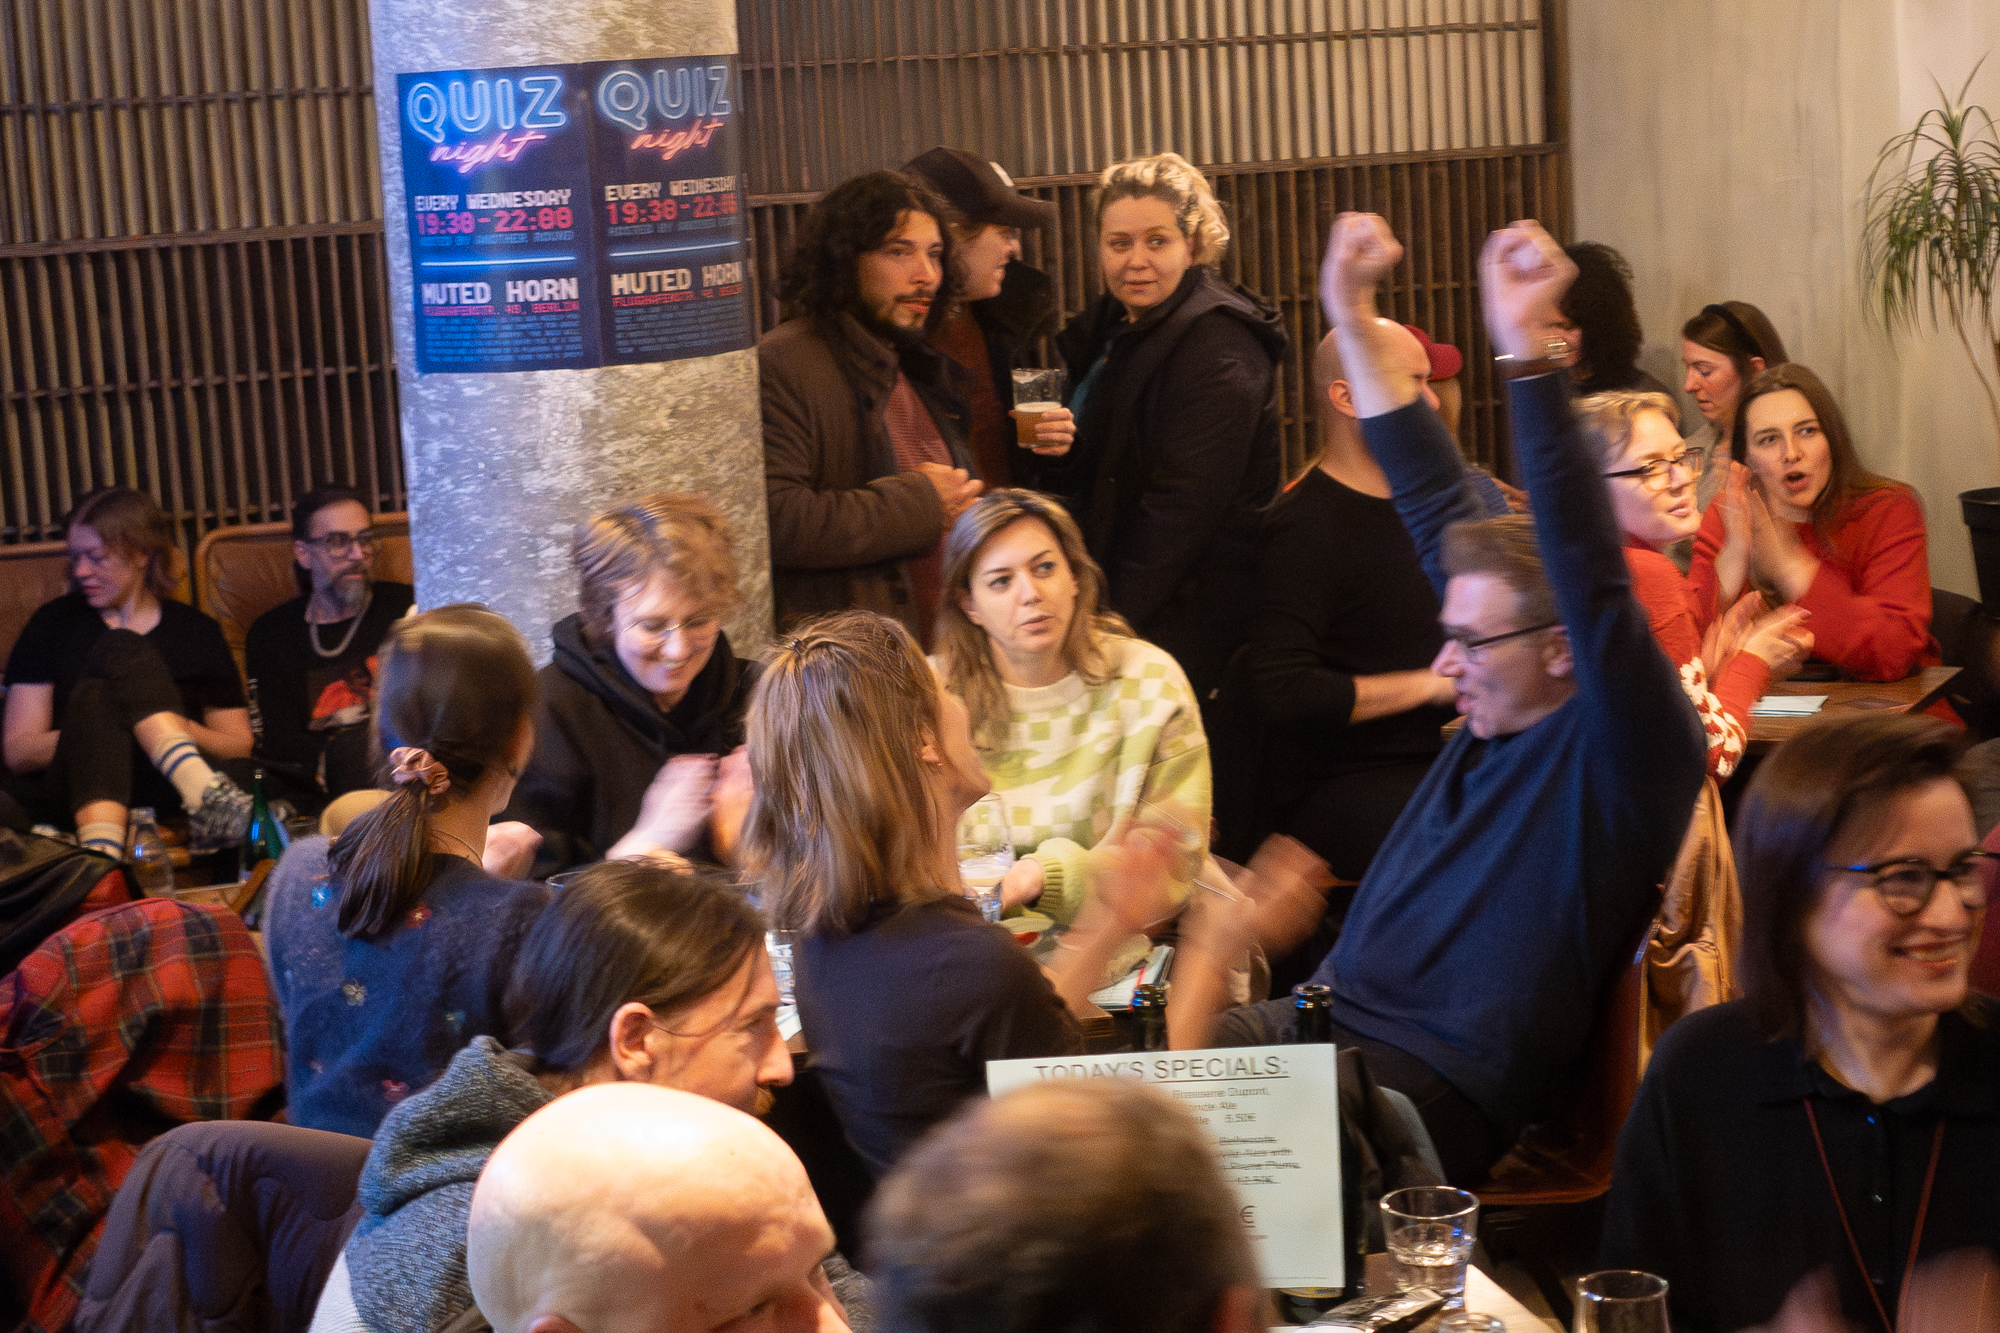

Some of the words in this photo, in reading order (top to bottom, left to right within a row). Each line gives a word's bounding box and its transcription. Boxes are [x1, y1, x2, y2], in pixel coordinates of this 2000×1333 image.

[407, 75, 566, 143] QUIZ
[598, 65, 732, 131] QUIZ
[429, 130, 547, 173] night
[630, 117, 724, 160] night
[414, 195, 459, 211] EVERY
[466, 189, 571, 210] WEDNESDAY
[604, 182, 662, 201] EVERY
[669, 175, 737, 196] WEDNESDAY
[421, 282, 491, 304] MUTED
[505, 277, 579, 303] HORN
[610, 268, 693, 296] MUTED
[701, 261, 743, 288] HORN
[1153, 1056, 1289, 1079] SPECIALS:
